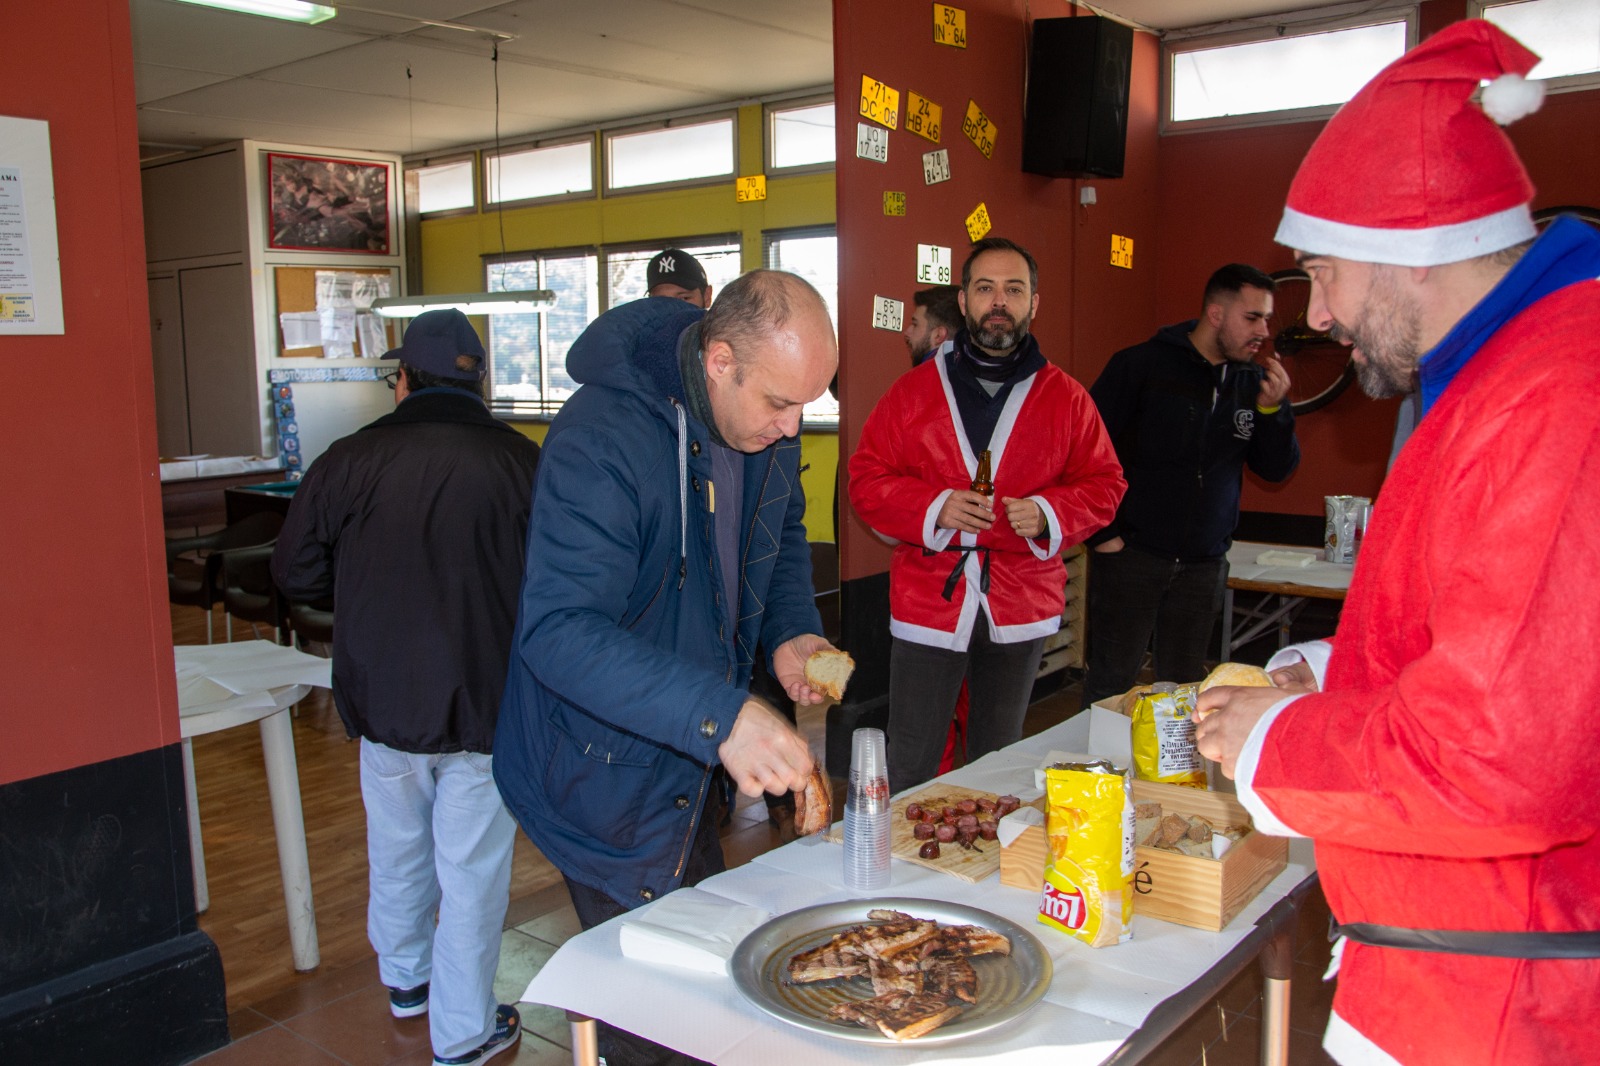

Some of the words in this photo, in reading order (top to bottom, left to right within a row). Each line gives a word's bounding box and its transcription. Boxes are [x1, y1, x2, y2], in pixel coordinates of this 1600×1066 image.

[944, 8, 956, 26] 52
[874, 82, 886, 102] 71
[918, 98, 930, 118] 24
[976, 112, 988, 133] 32
[745, 178, 757, 188] 70
[659, 255, 675, 273] NY
[883, 299, 894, 314] 65
